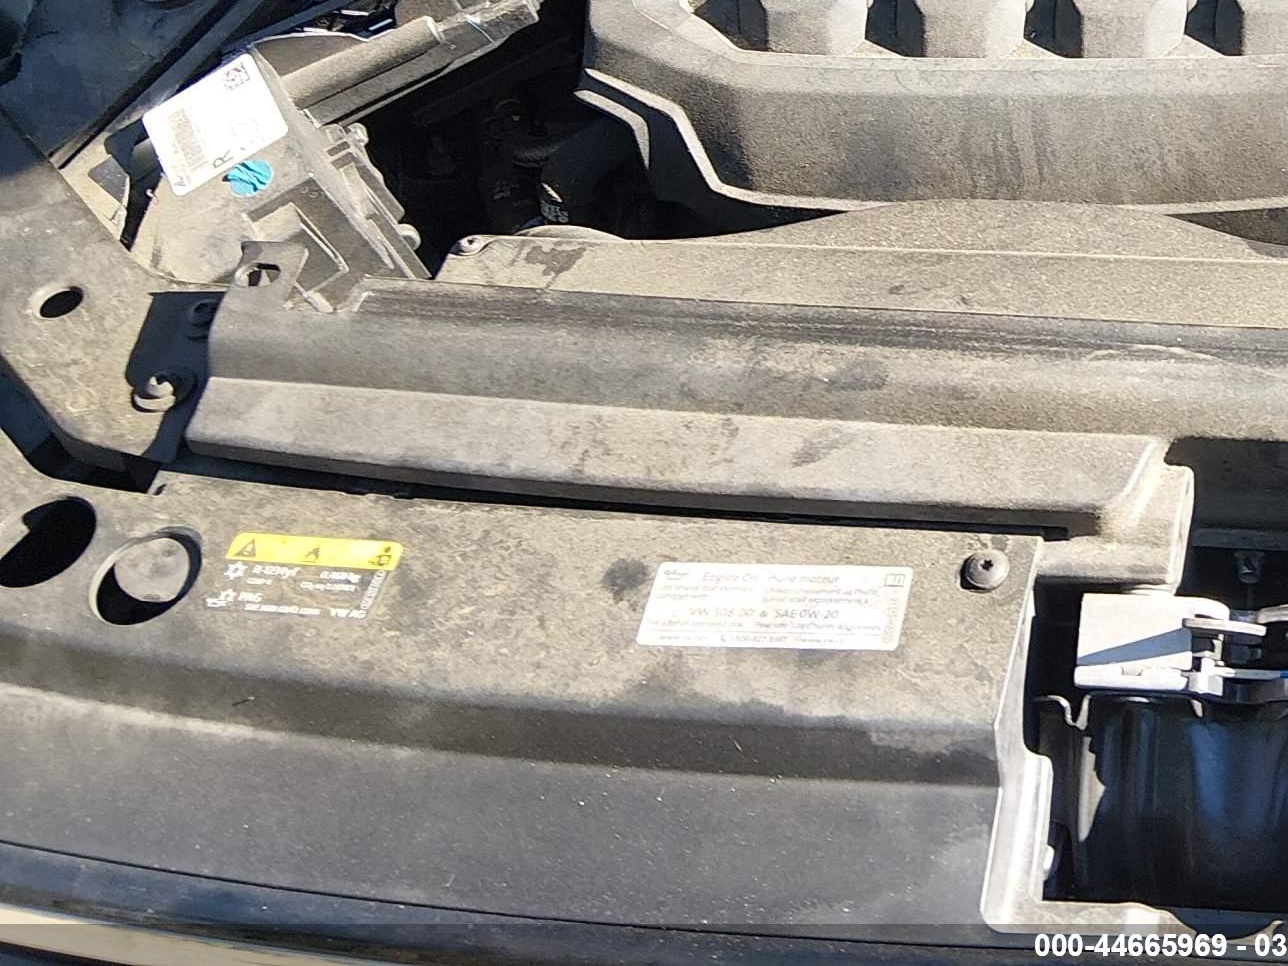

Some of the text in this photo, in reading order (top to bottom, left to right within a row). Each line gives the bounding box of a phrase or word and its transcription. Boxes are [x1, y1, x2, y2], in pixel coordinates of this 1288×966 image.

[702, 571, 759, 585] Engine Oil
[774, 608, 798, 619] SAE
[799, 609, 840, 619] 0W-20
